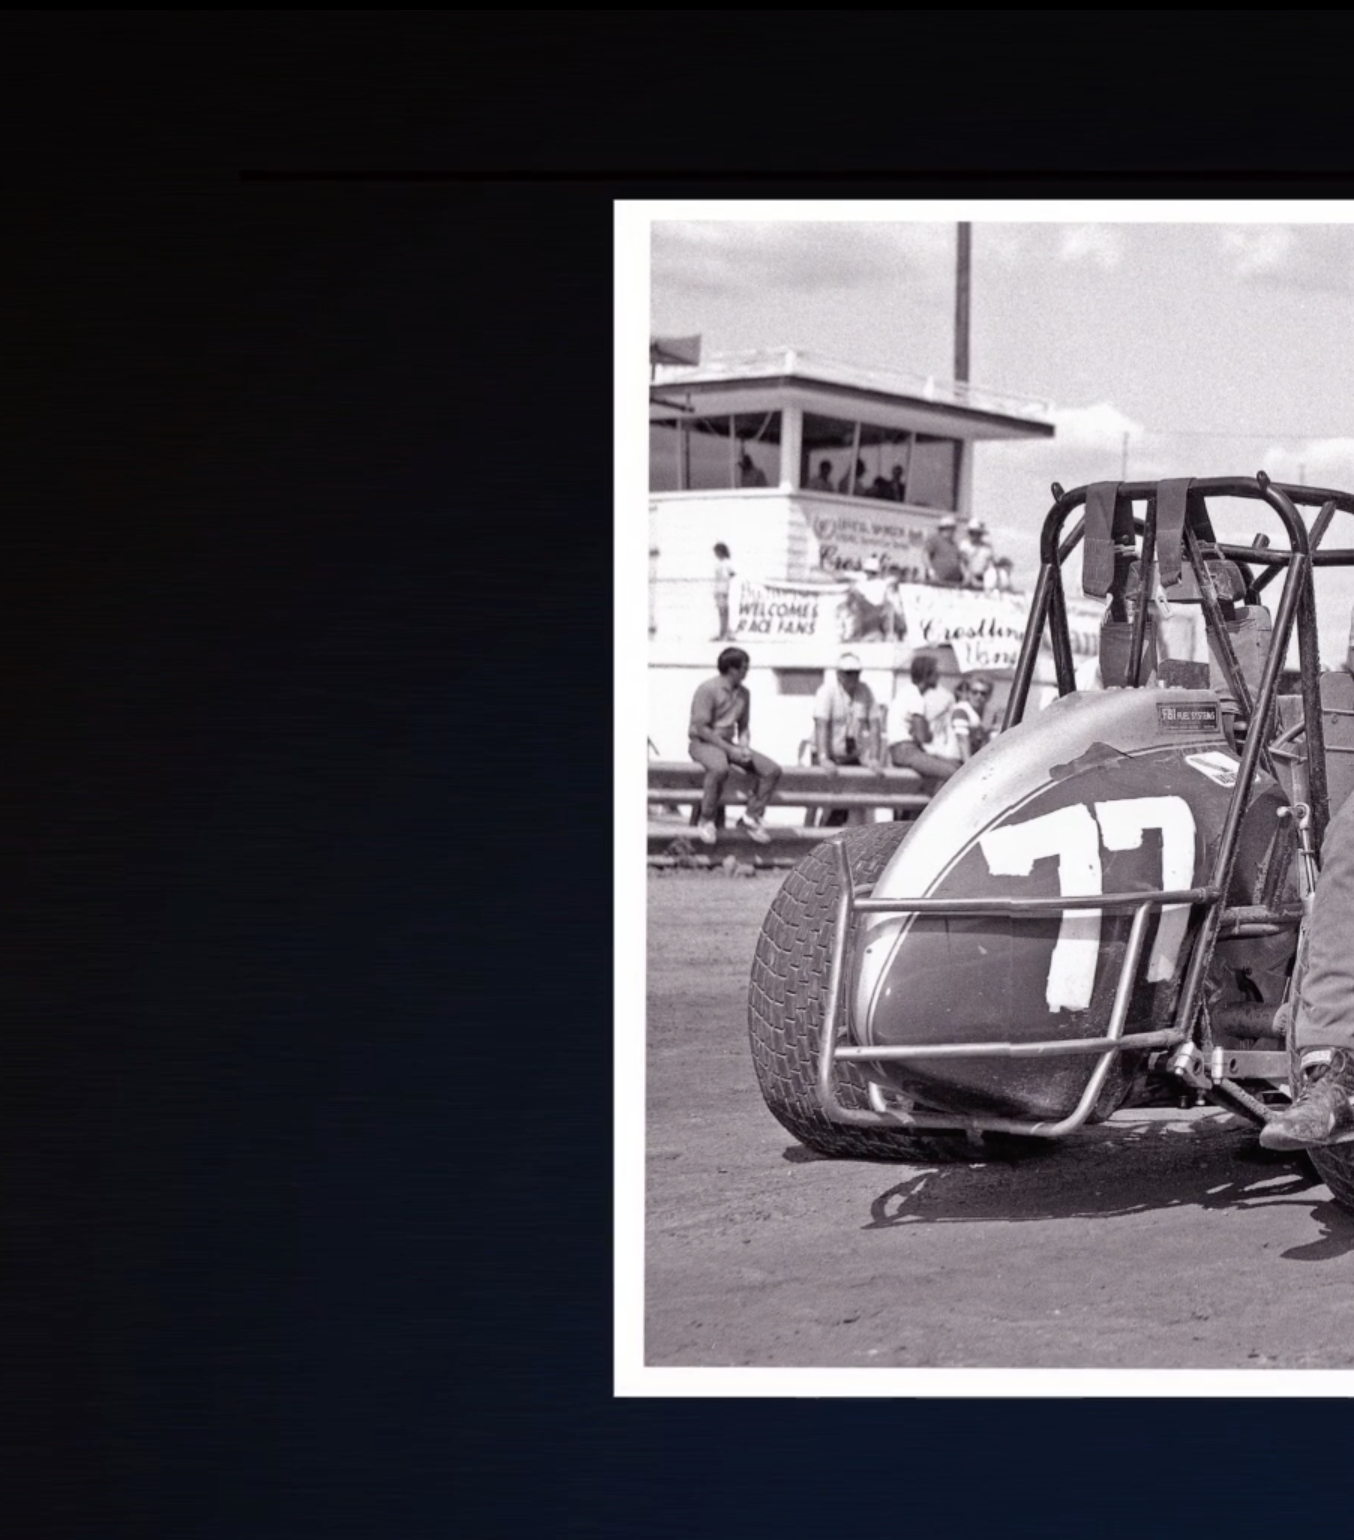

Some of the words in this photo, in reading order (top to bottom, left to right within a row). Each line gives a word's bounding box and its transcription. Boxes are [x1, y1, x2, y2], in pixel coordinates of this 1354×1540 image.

[739, 601, 819, 618] WELCOMES
[777, 621, 816, 636] FANS
[1191, 711, 1215, 720] SYSTEMS
[980, 795, 1197, 1013] 77
